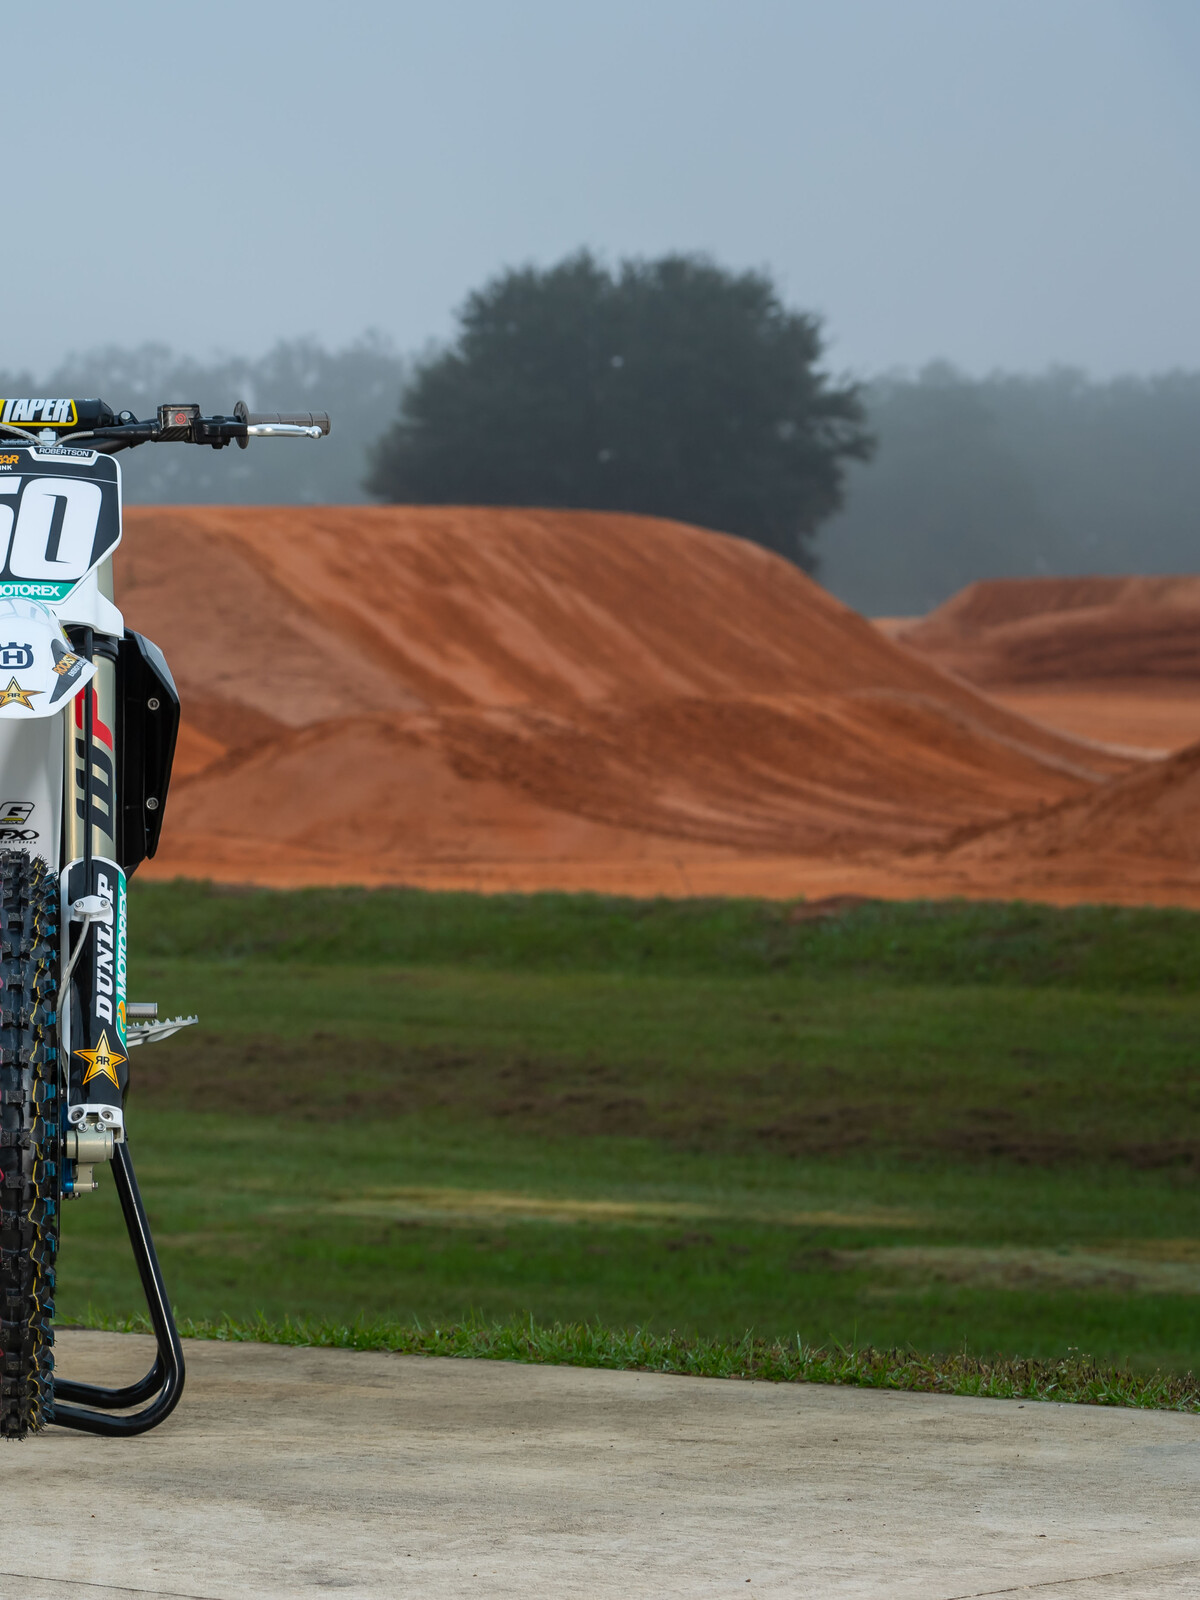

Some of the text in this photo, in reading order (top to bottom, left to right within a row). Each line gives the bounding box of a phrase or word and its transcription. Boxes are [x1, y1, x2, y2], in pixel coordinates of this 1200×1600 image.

[38, 447, 90, 457] ROBERTSON
[96, 872, 113, 1025] DUNLP
[117, 884, 127, 1001] MOTOREX
